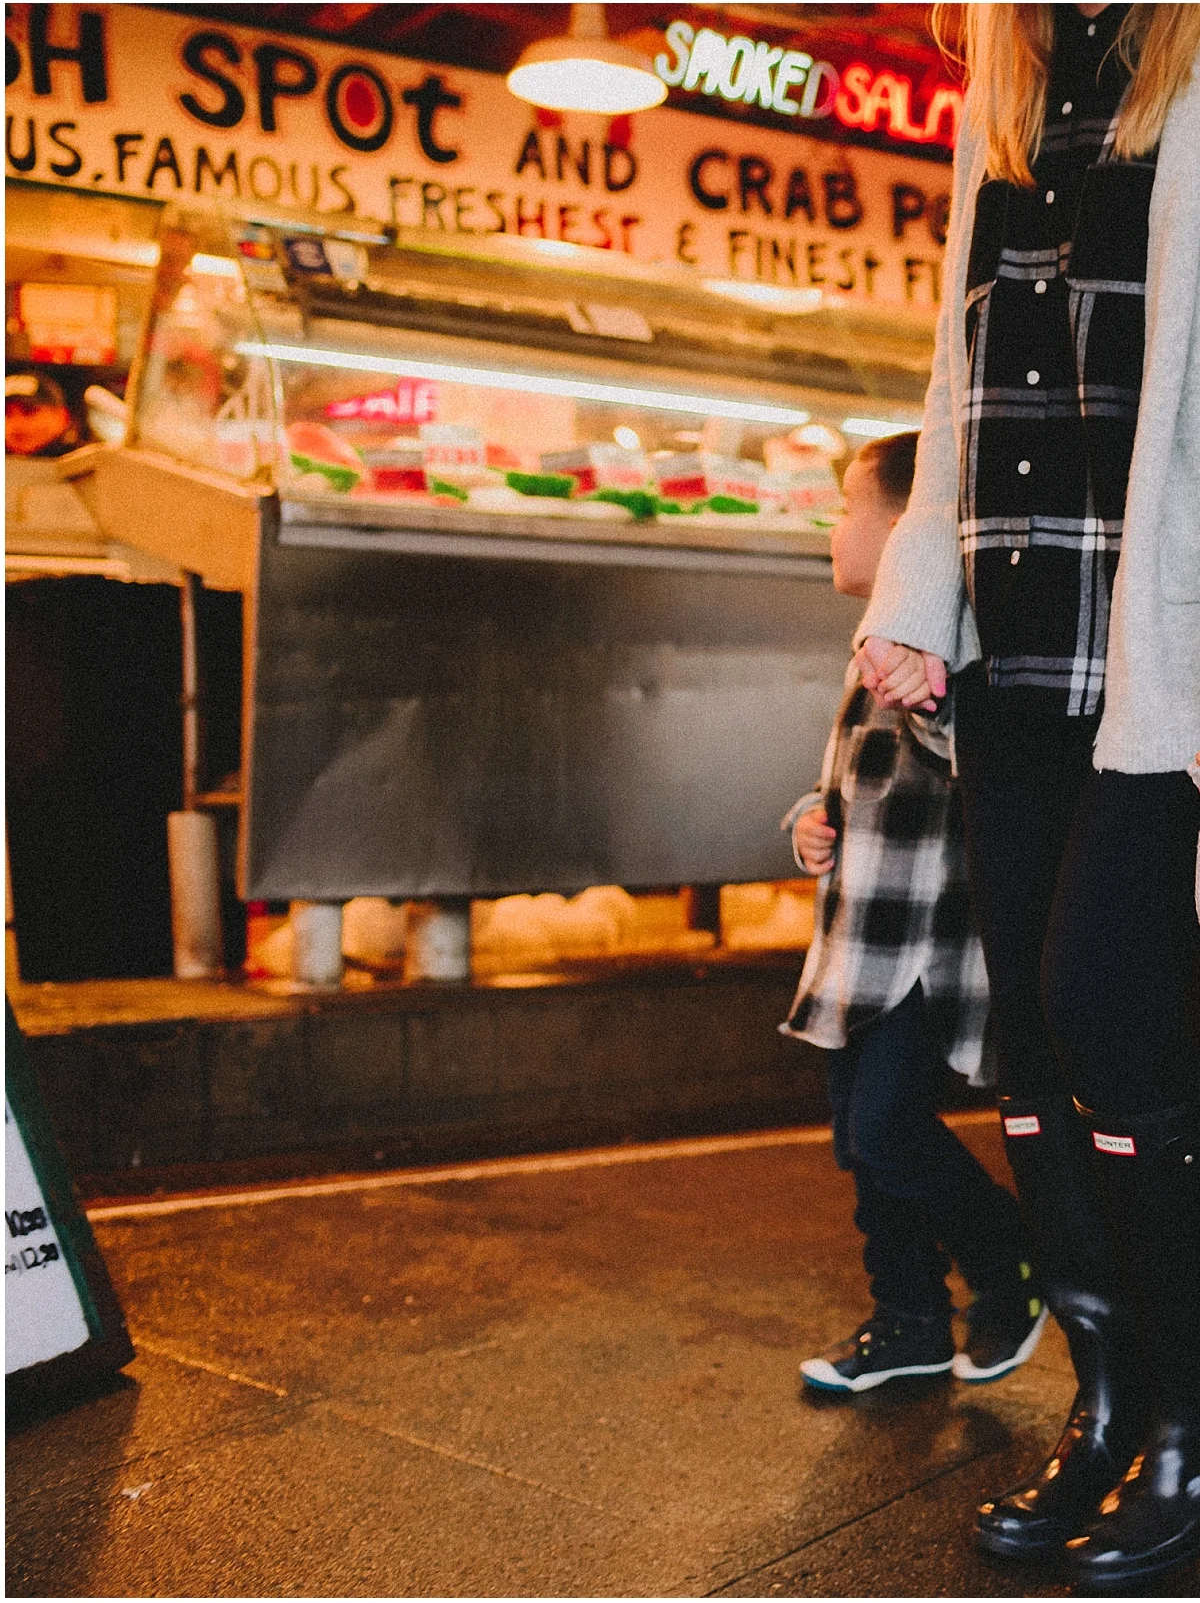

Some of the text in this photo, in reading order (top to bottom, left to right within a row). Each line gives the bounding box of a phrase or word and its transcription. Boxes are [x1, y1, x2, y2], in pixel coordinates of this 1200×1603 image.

[653, 19, 838, 119] SMOKED
[514, 128, 638, 193] AND
[689, 149, 863, 230] CRAB
[1096, 1138, 1132, 1149] HUNTER
